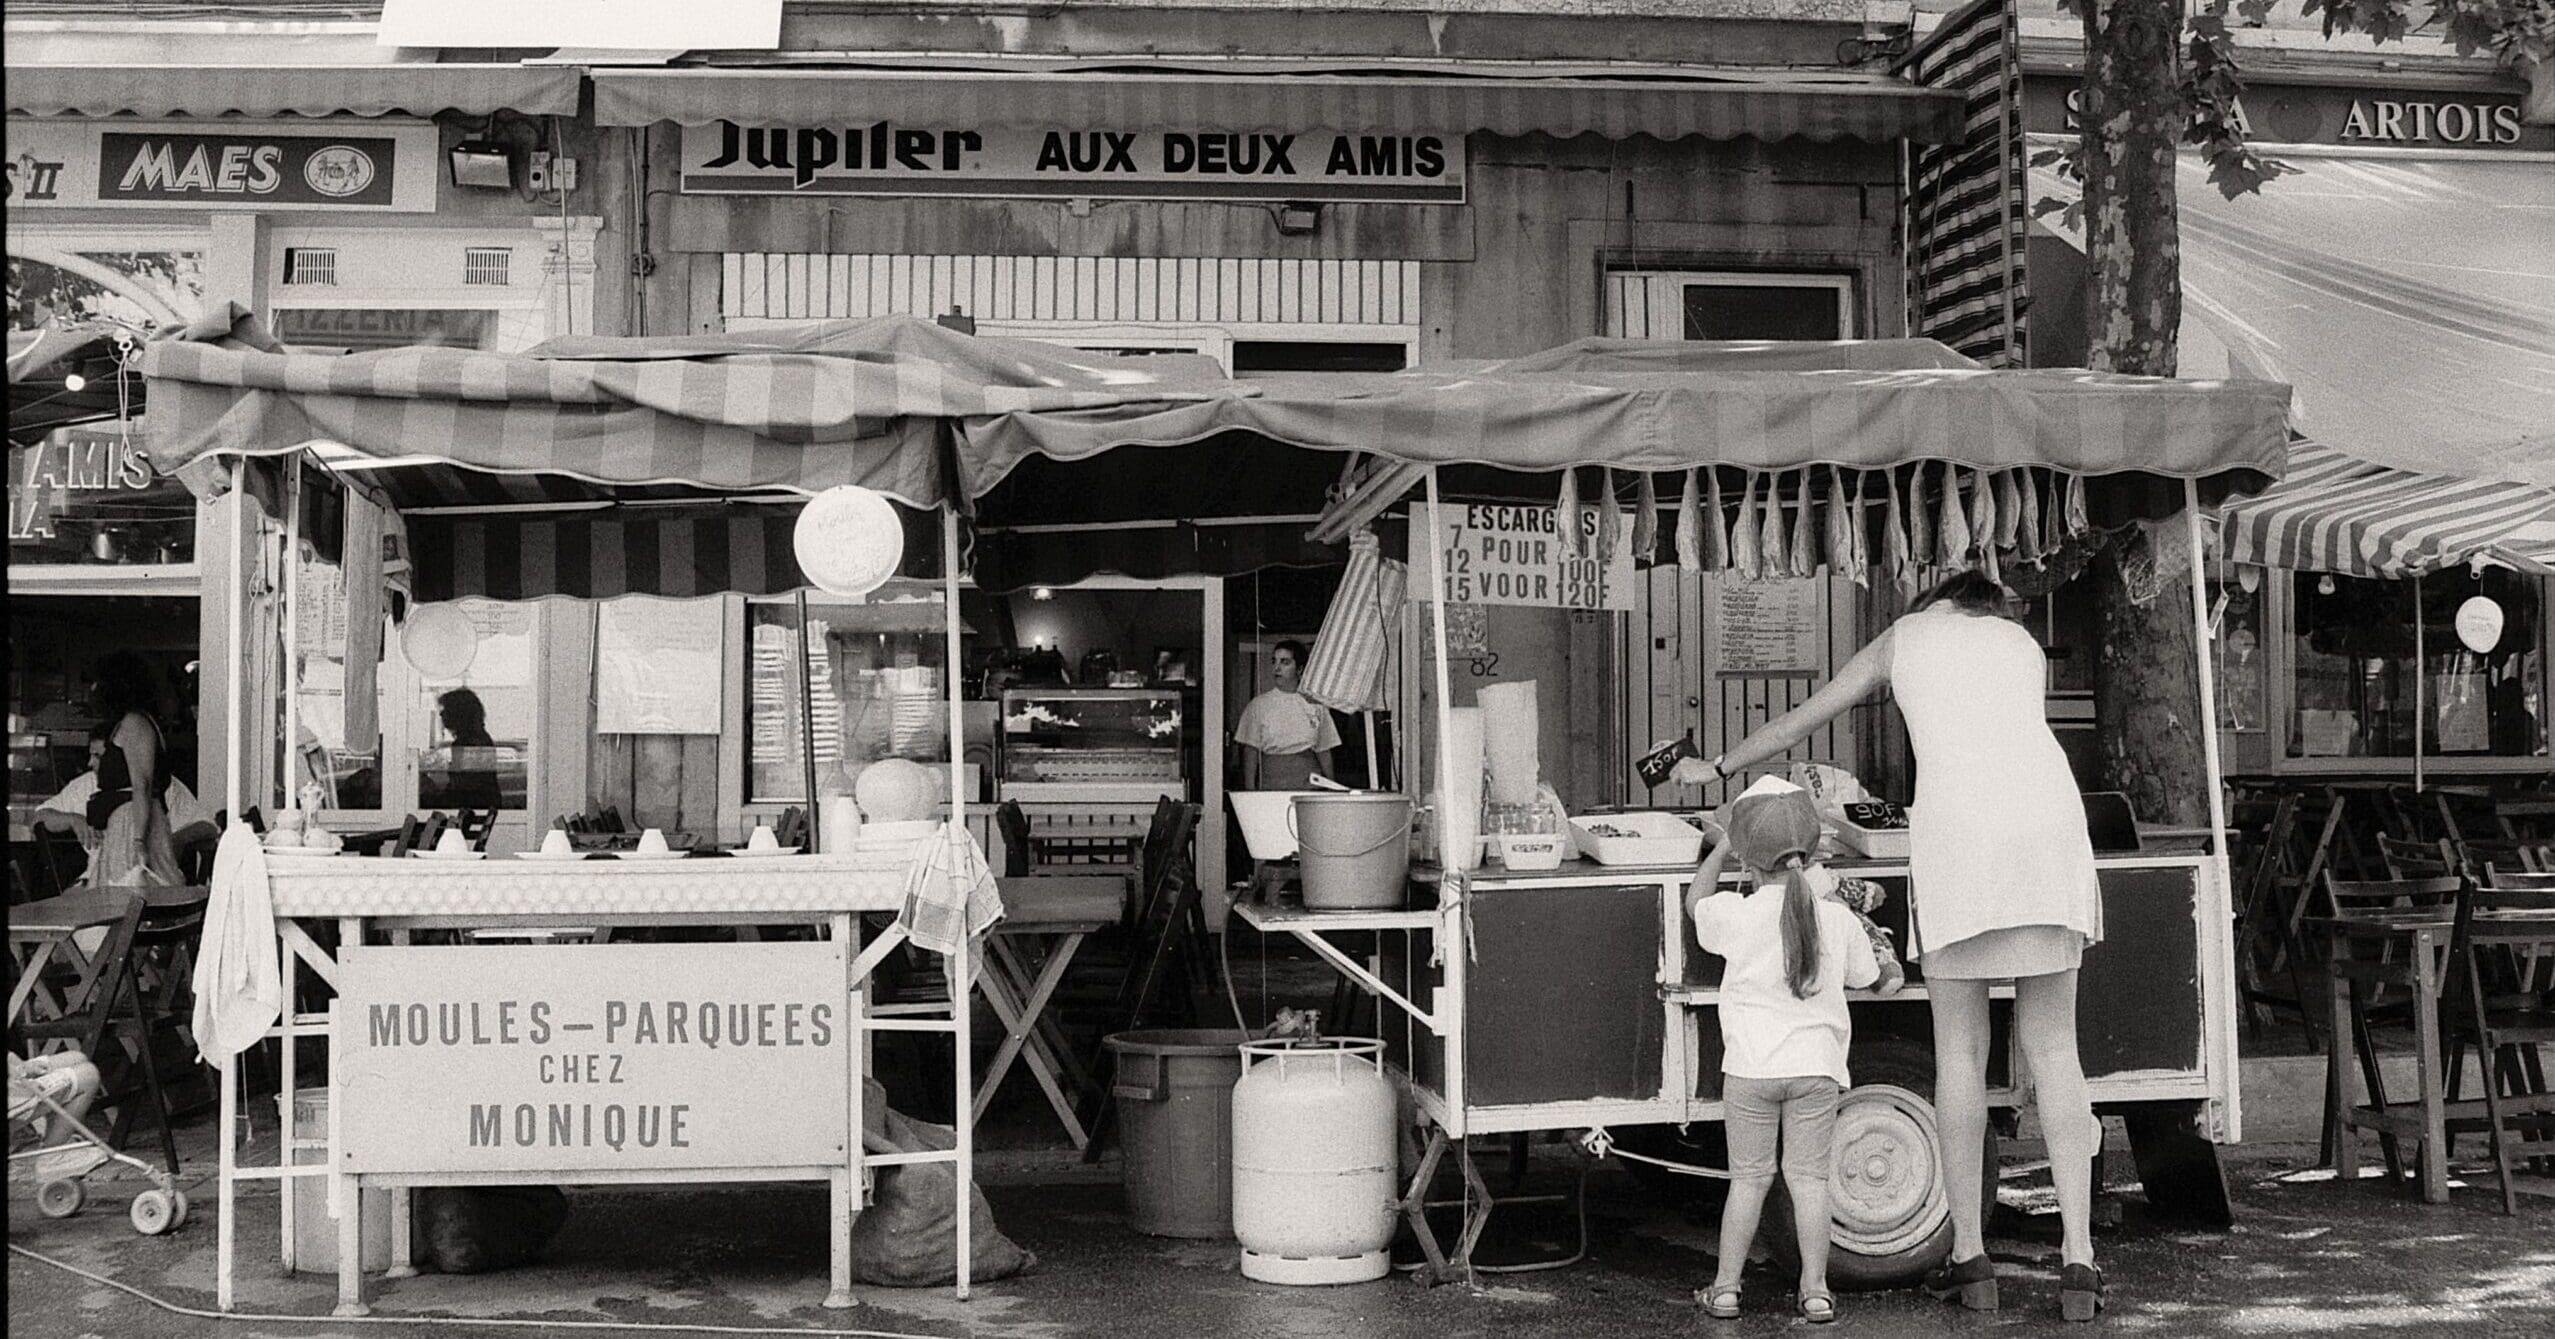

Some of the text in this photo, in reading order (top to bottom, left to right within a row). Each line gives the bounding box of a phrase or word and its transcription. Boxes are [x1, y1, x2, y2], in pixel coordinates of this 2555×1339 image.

[2340, 99, 2521, 144] ARTOIS
[118, 141, 282, 194] MAES
[700, 118, 982, 187] Jupiler
[1036, 131, 1445, 178] AUX DEUX AMIS
[27, 441, 151, 489] AMIS
[1445, 548, 1470, 574] 12
[1450, 524, 1462, 549] 7
[1482, 536, 1547, 565] POUR
[1445, 576, 1611, 609] 15 120F
[1479, 572, 1548, 599] VOOR
[1471, 652, 1499, 677] 82
[539, 1054, 624, 1083] CHEZ
[469, 1103, 690, 1152] MONIQUE
